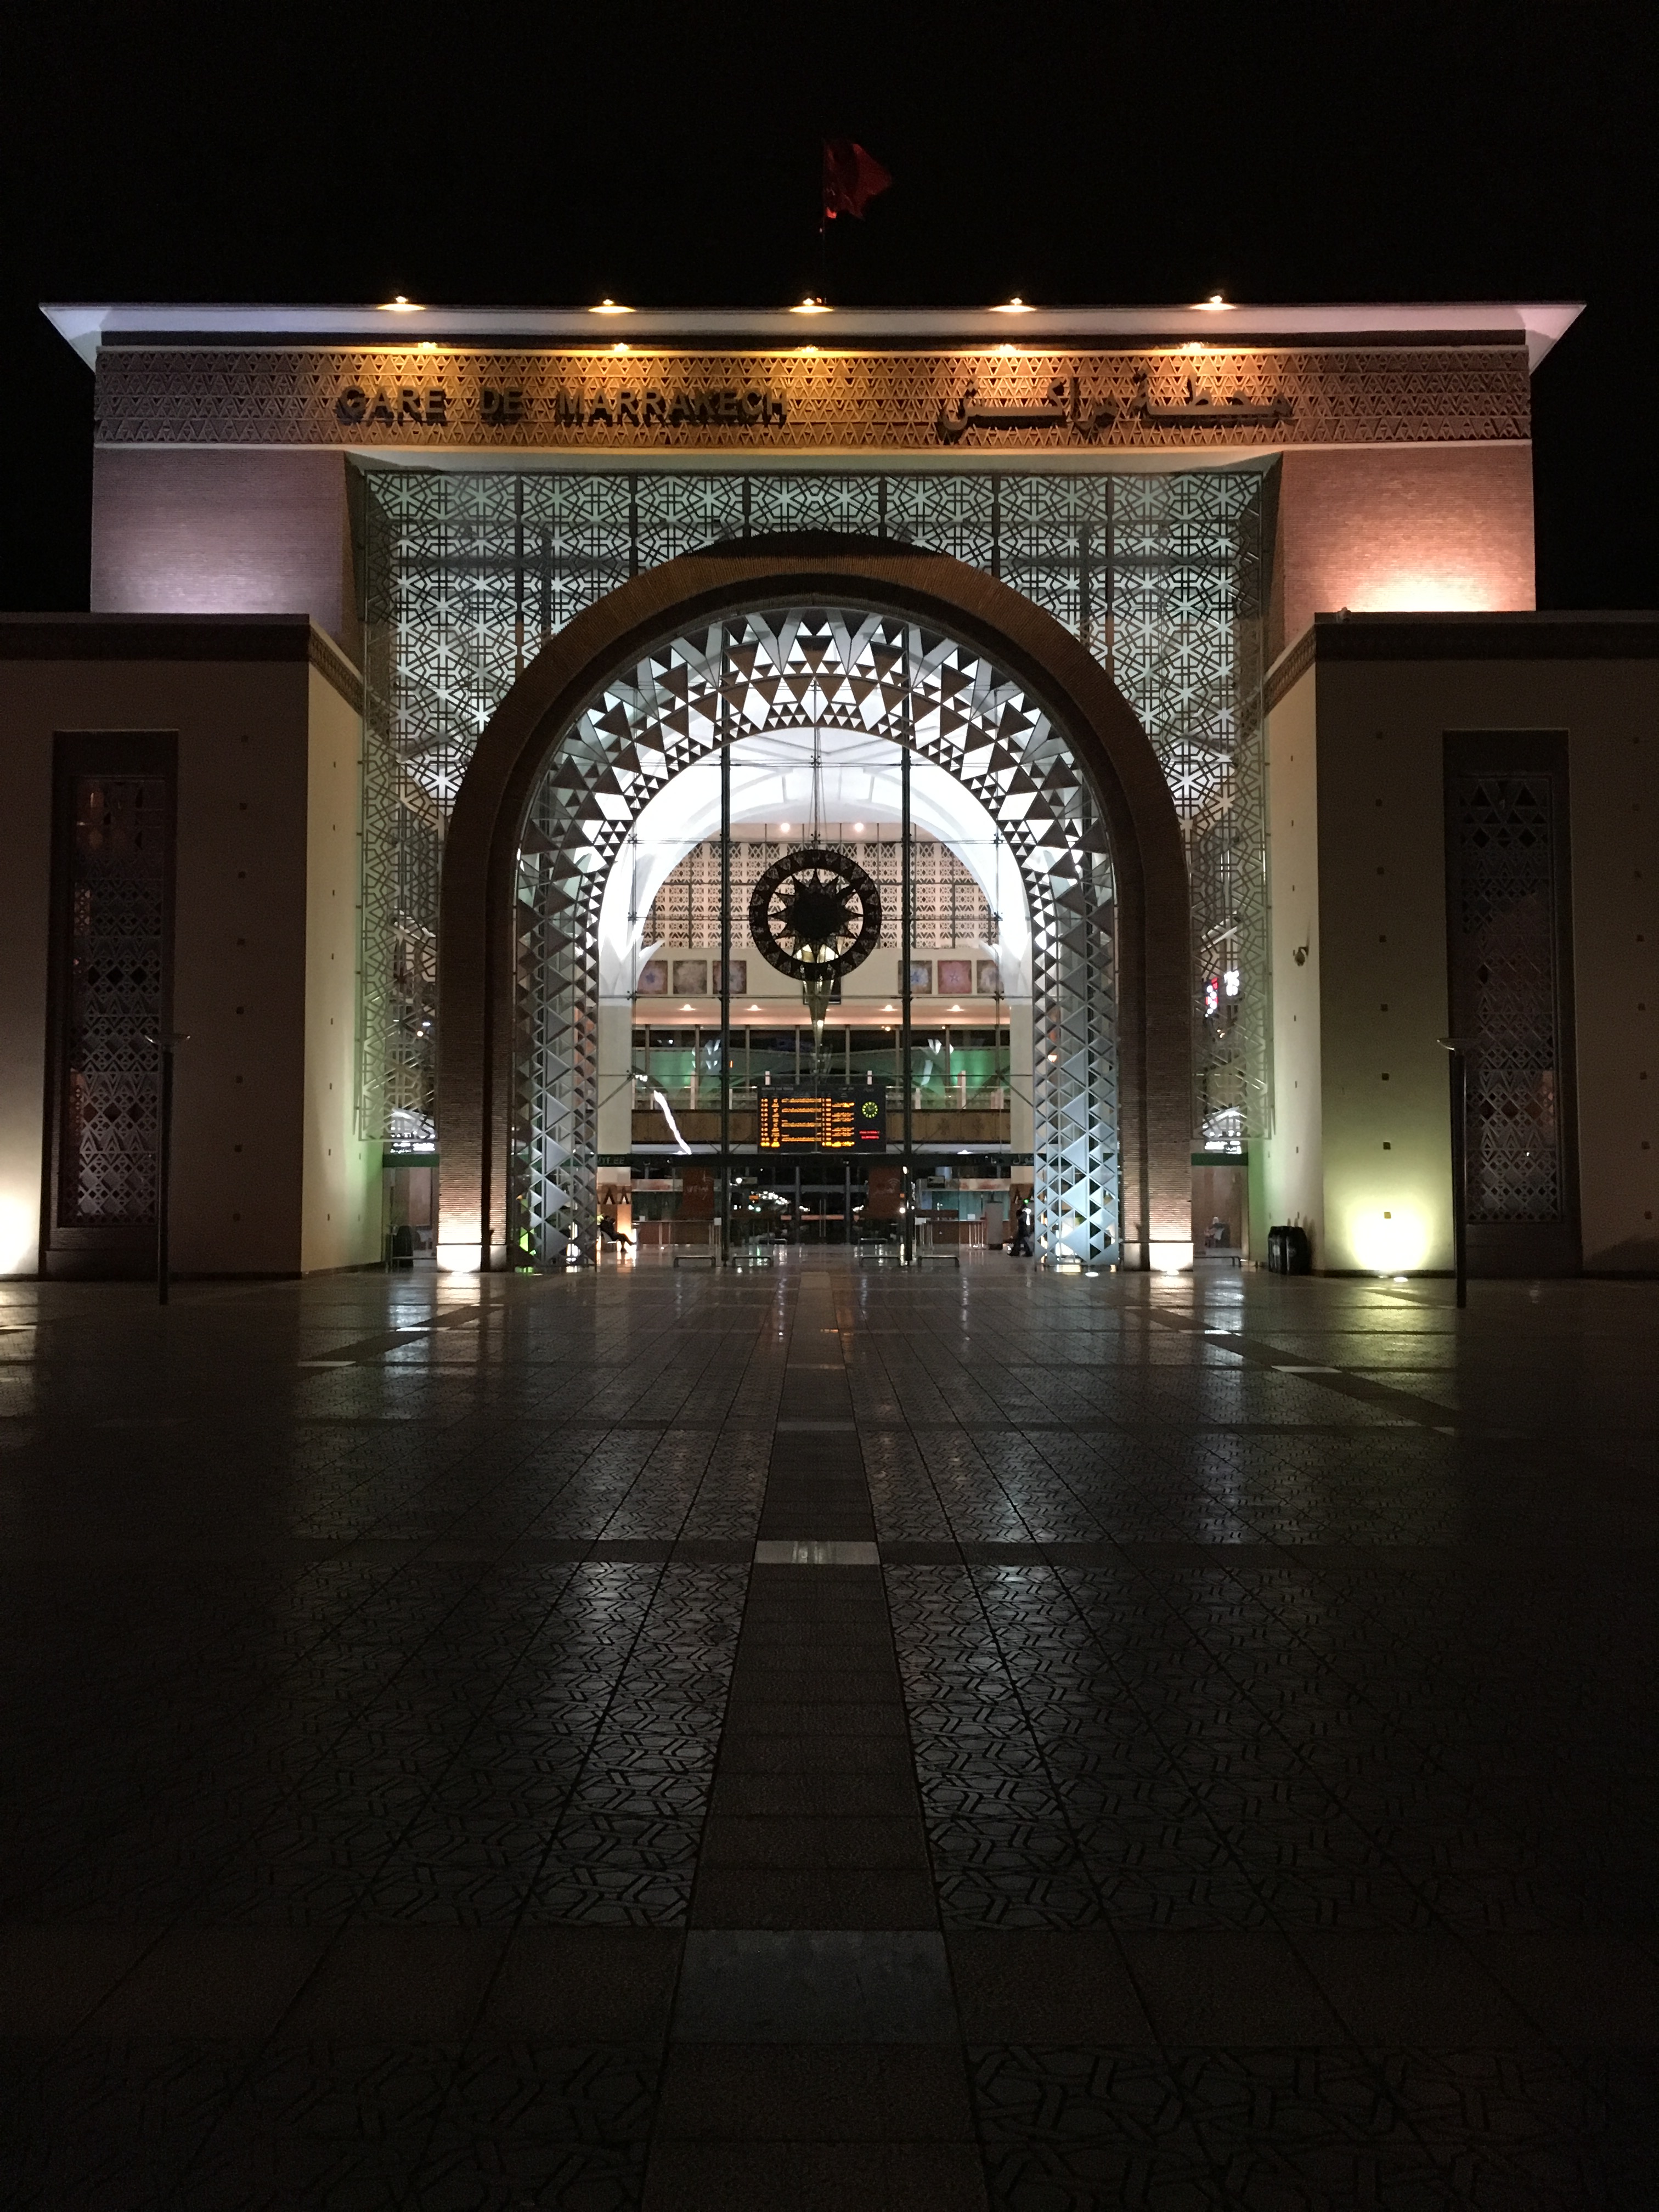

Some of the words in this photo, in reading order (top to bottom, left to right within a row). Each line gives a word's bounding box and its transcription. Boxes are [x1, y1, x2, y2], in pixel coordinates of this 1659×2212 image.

[342, 386, 445, 415] GARE
[481, 386, 523, 415] DE
[558, 387, 787, 415] MARRAKECH
[942, 374, 1118, 431] مراكش
[1126, 369, 1291, 419] محطة
